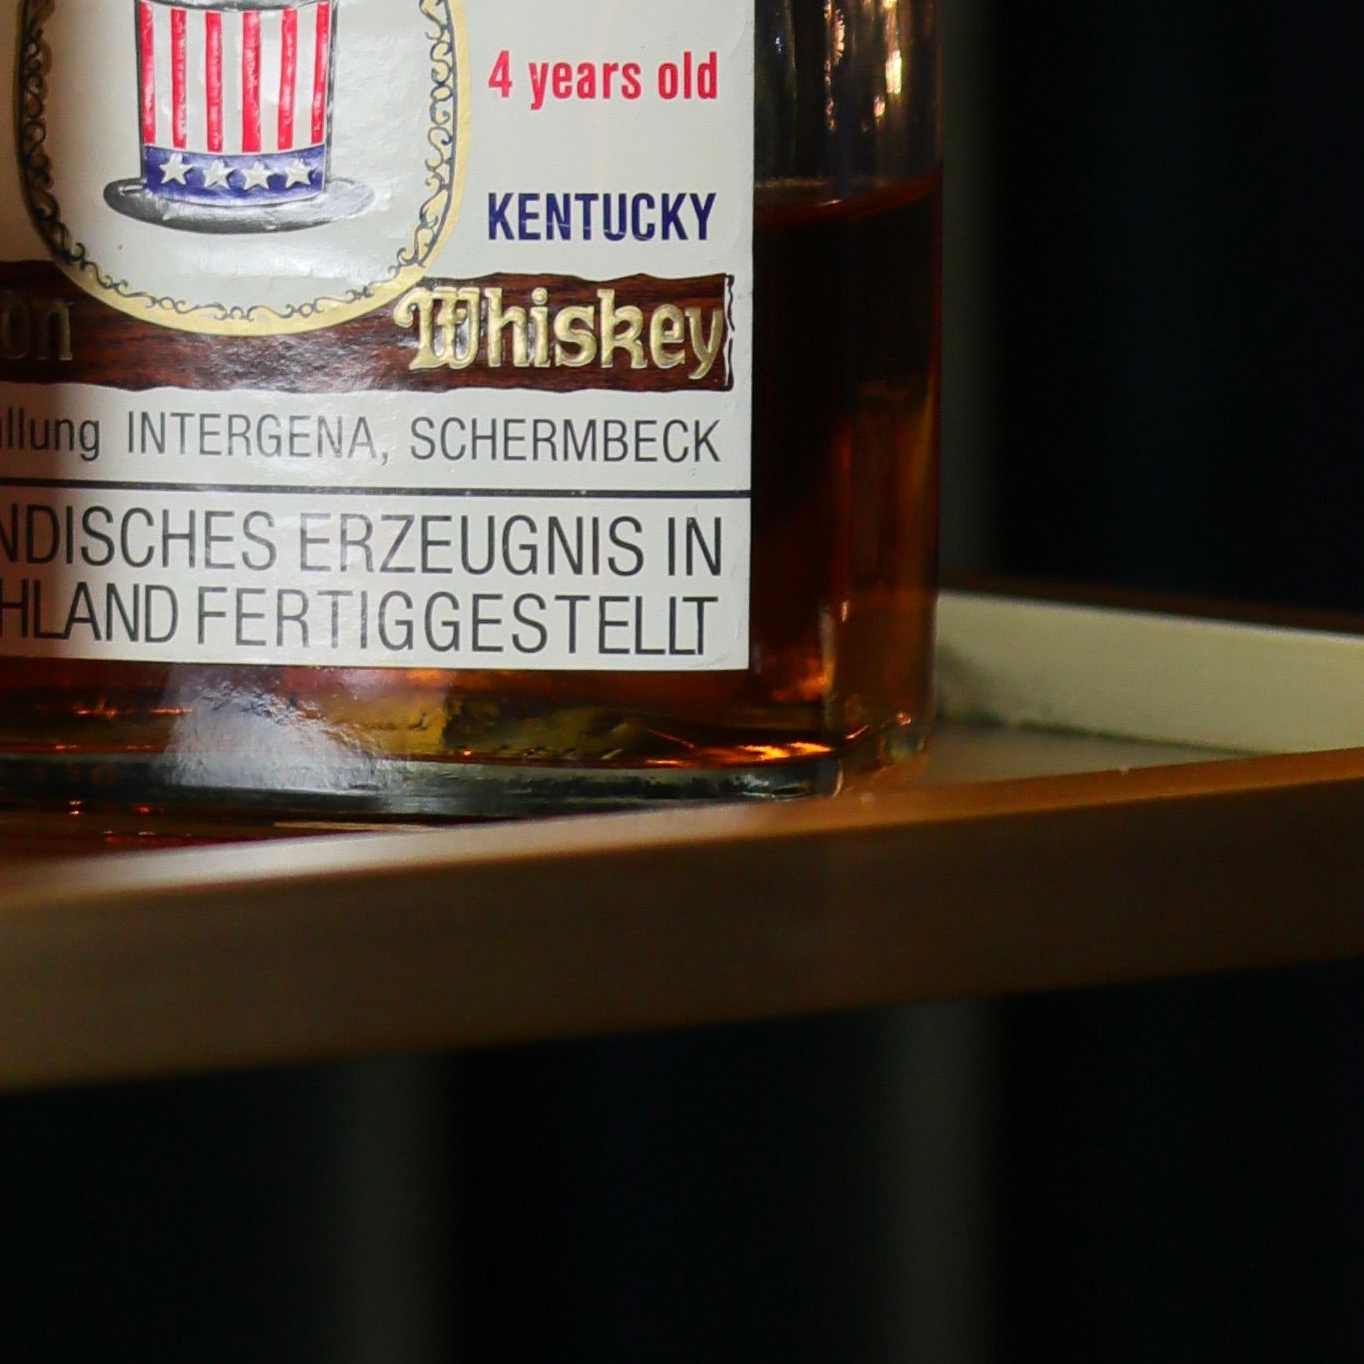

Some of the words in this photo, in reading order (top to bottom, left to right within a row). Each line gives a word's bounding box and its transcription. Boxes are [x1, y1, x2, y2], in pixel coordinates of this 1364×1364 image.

[488, 52, 514, 99] 4
[528, 59, 641, 110] years
[657, 50, 719, 100] old
[488, 192, 717, 242] KENTUCKY
[394, 284, 724, 380] Whiskey
[126, 410, 390, 466] INTERGENA,
[410, 417, 721, 464] SCHERMBECK
[300, 512, 646, 577] ERZEUGNIS
[669, 515, 723, 577] IN
[198, 586, 719, 657] FERTIGGESTELLT
